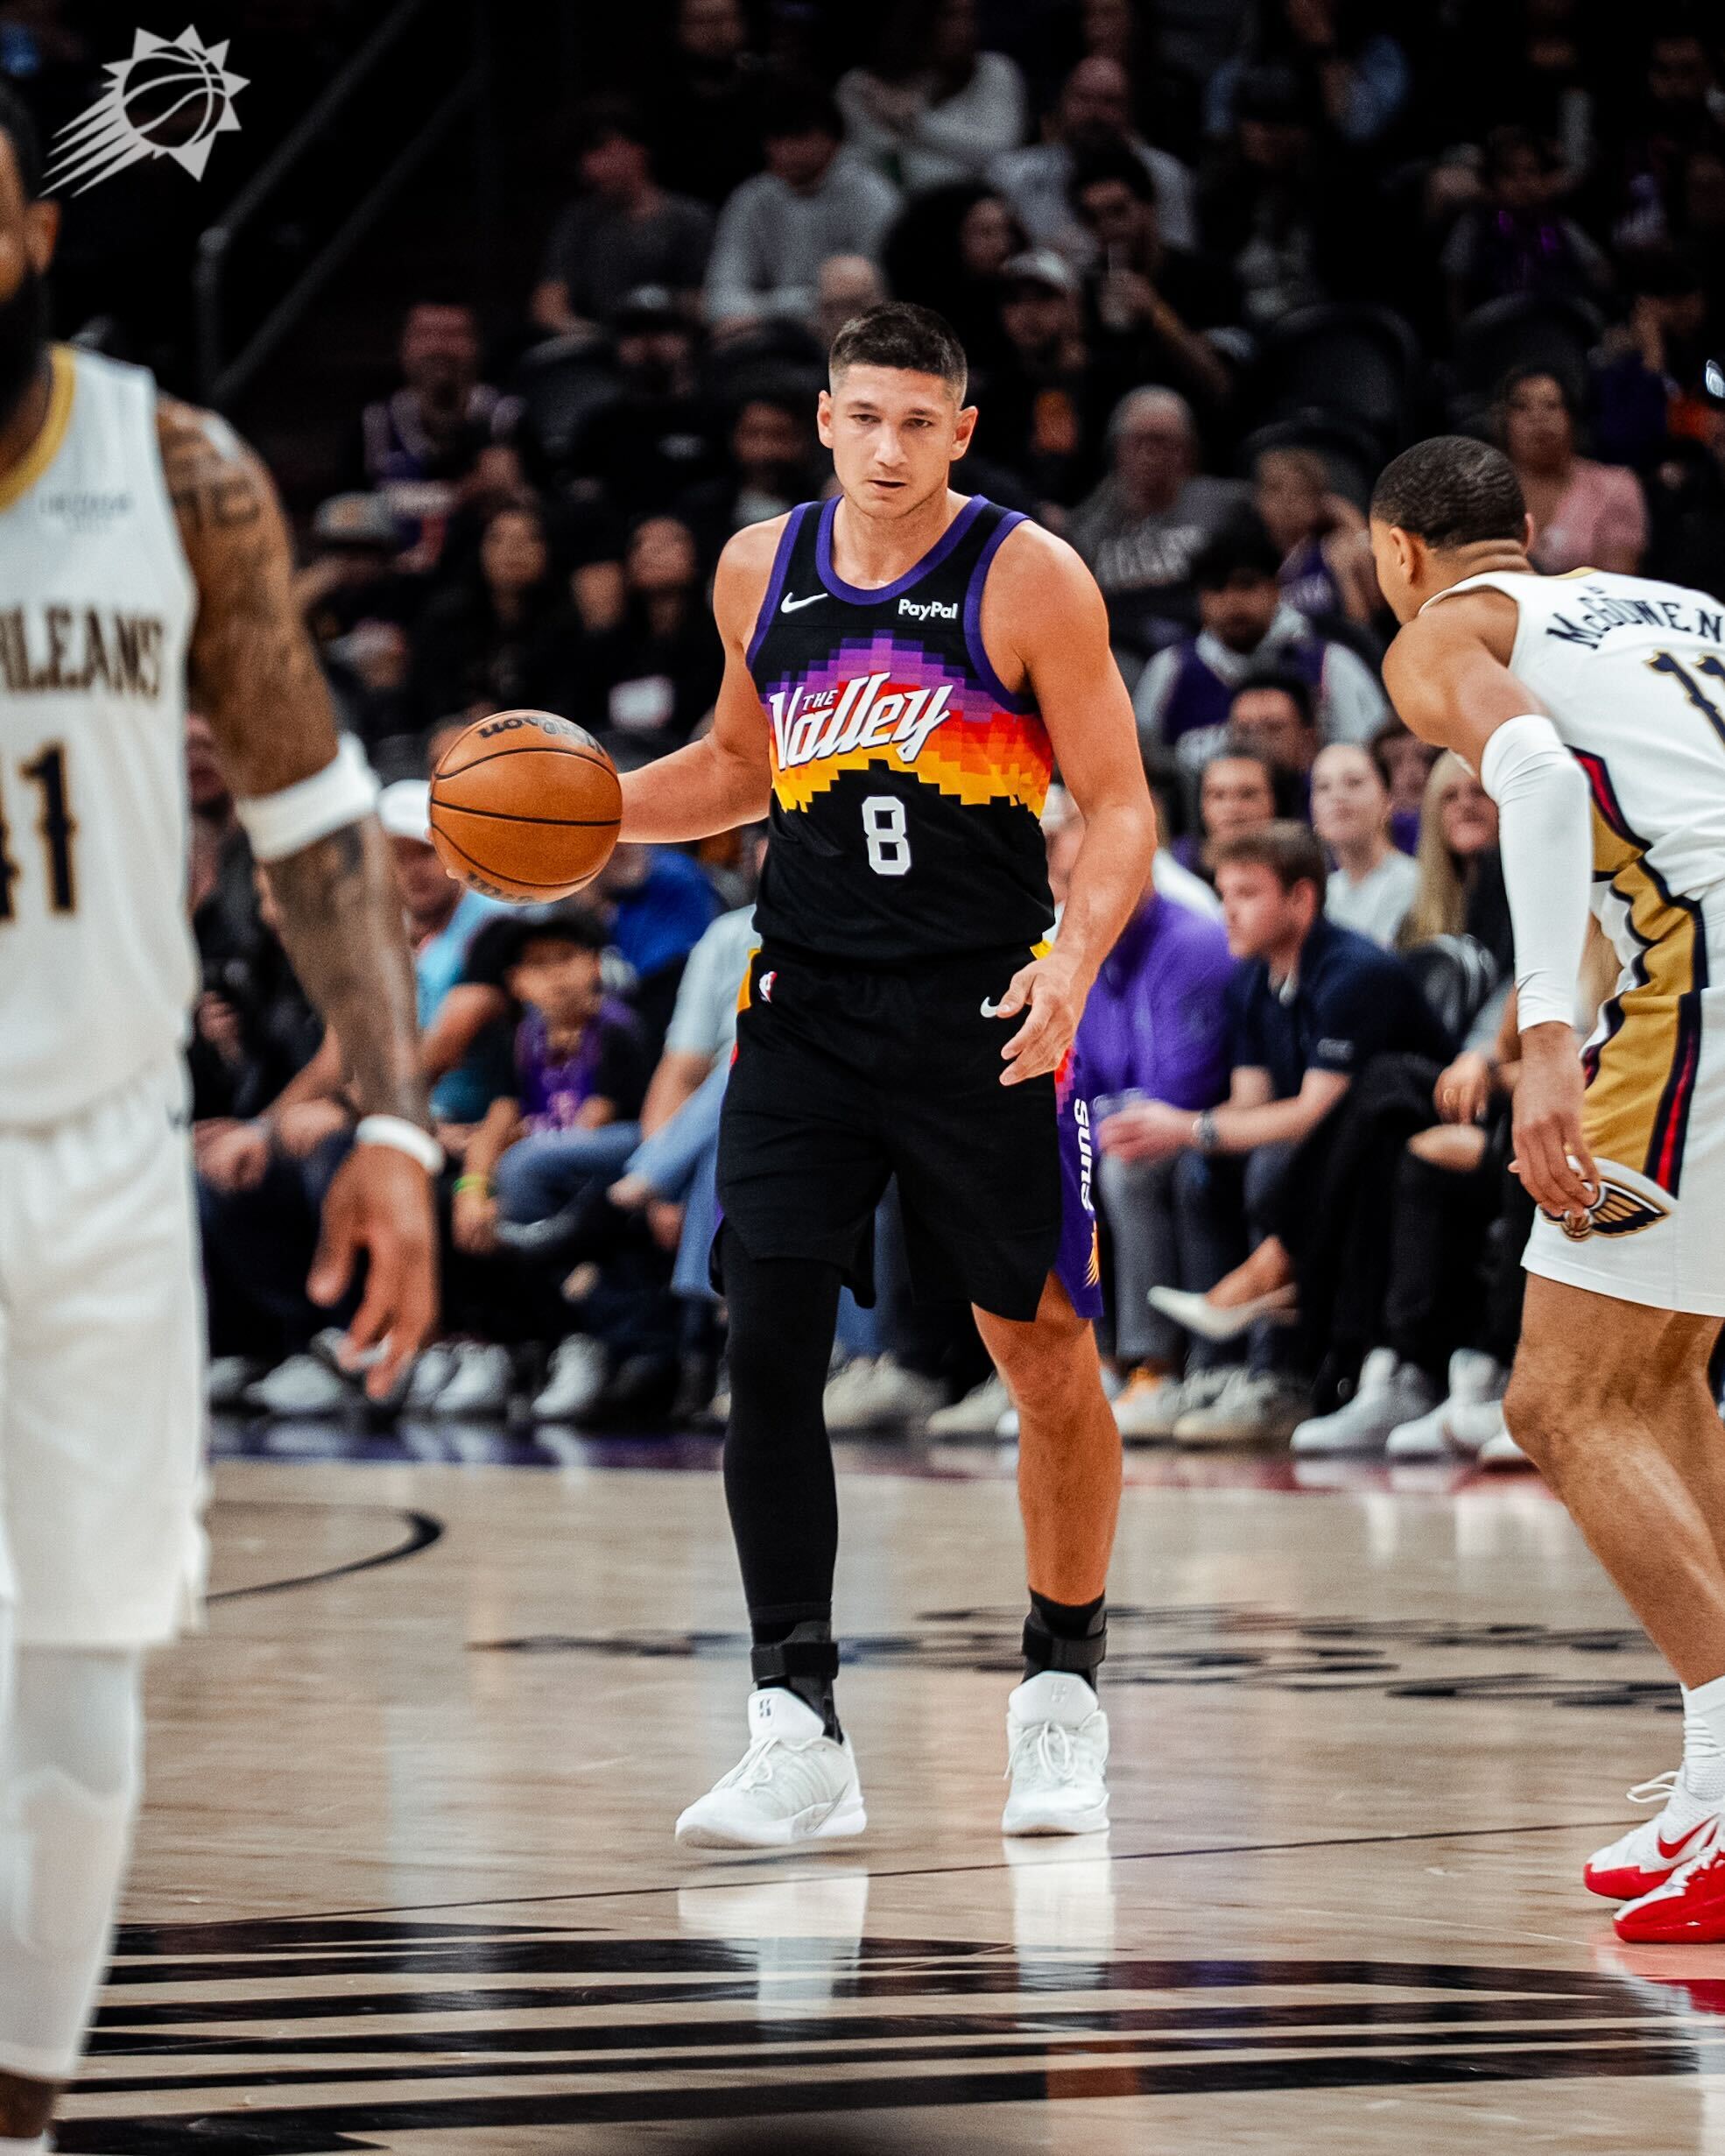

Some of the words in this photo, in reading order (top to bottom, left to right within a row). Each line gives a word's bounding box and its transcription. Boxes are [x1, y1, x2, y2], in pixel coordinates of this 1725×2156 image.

[898, 599, 958, 621] PayPal
[0, 604, 164, 698] LEANS
[769, 672, 954, 770] Valley
[803, 689, 838, 711] THE
[862, 796, 912, 876] 8
